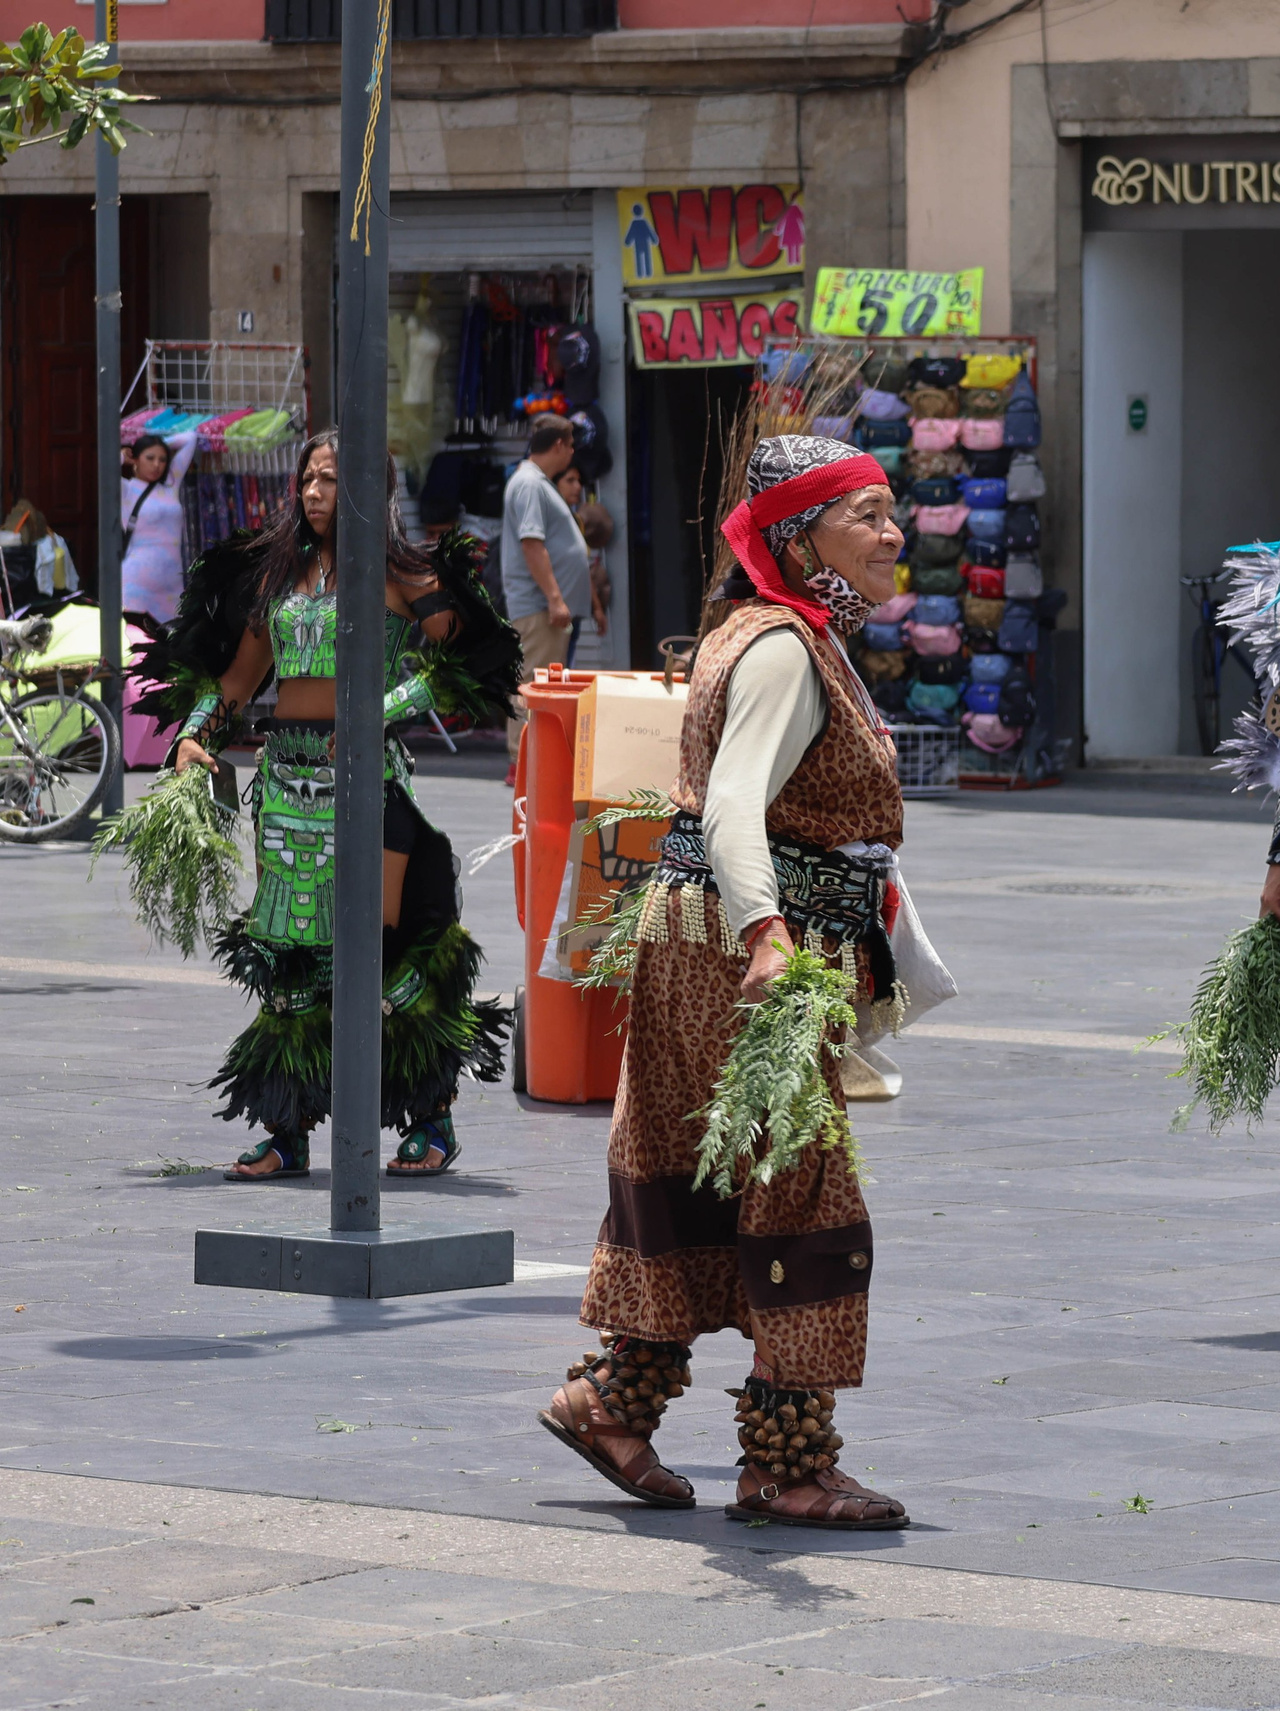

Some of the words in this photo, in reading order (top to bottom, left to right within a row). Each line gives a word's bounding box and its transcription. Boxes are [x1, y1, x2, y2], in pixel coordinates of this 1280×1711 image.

[648, 184, 786, 275] WC
[637, 299, 802, 363] BAÑOS
[857, 288, 939, 336] 50
